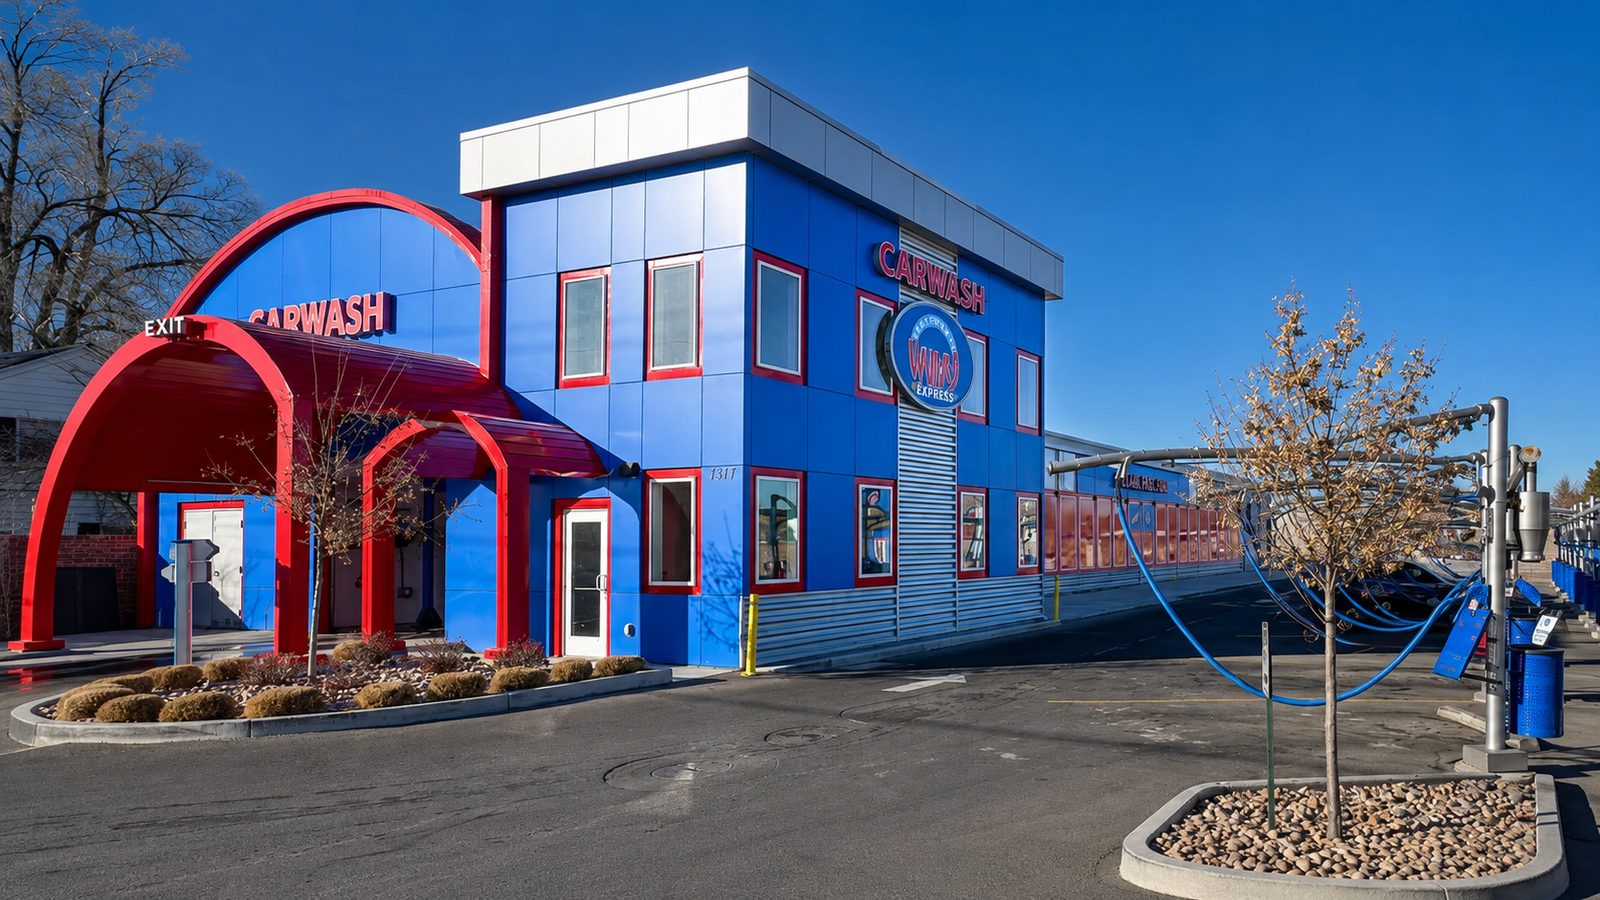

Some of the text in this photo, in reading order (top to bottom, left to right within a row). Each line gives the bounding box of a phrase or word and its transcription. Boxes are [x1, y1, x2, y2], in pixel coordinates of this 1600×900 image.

[878, 241, 985, 315] CARWASH
[144, 316, 184, 337] EXIT
[916, 383, 954, 403] EXPRESS
